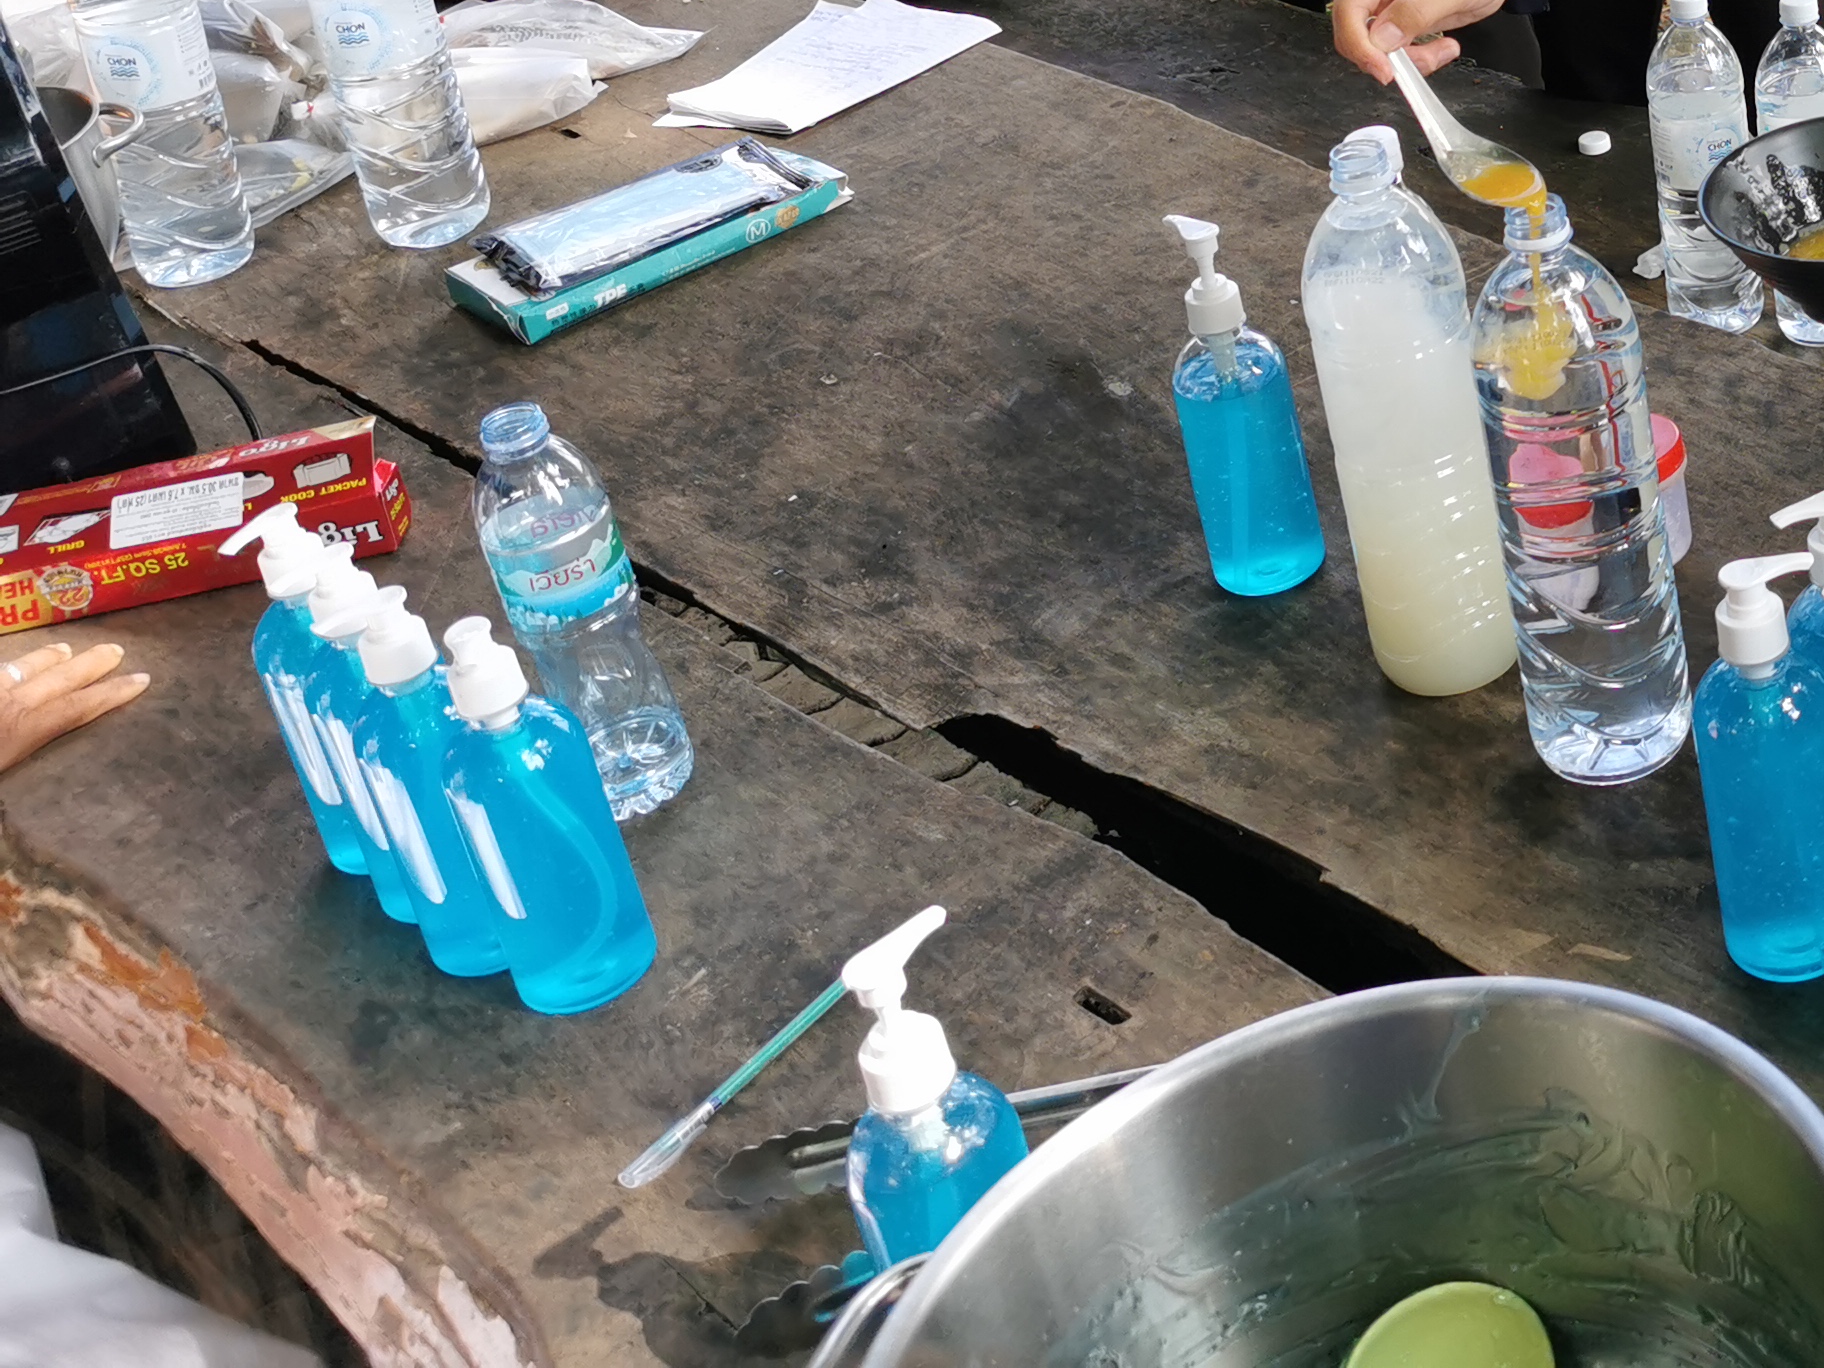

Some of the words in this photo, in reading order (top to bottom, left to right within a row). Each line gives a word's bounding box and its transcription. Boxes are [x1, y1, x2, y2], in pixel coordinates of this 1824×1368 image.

[335, 22, 366, 34] CHON
[107, 57, 137, 66] CHON
[1707, 138, 1732, 152] CHON
[750, 221, 767, 241] M
[593, 283, 629, 307] TPE
[319, 477, 367, 496] PACKET
[46, 539, 85, 555] GRILL
[164, 552, 189, 571] 25
[93, 558, 161, 585] SQ.FT.
[528, 557, 597, 592] เวียร่า
